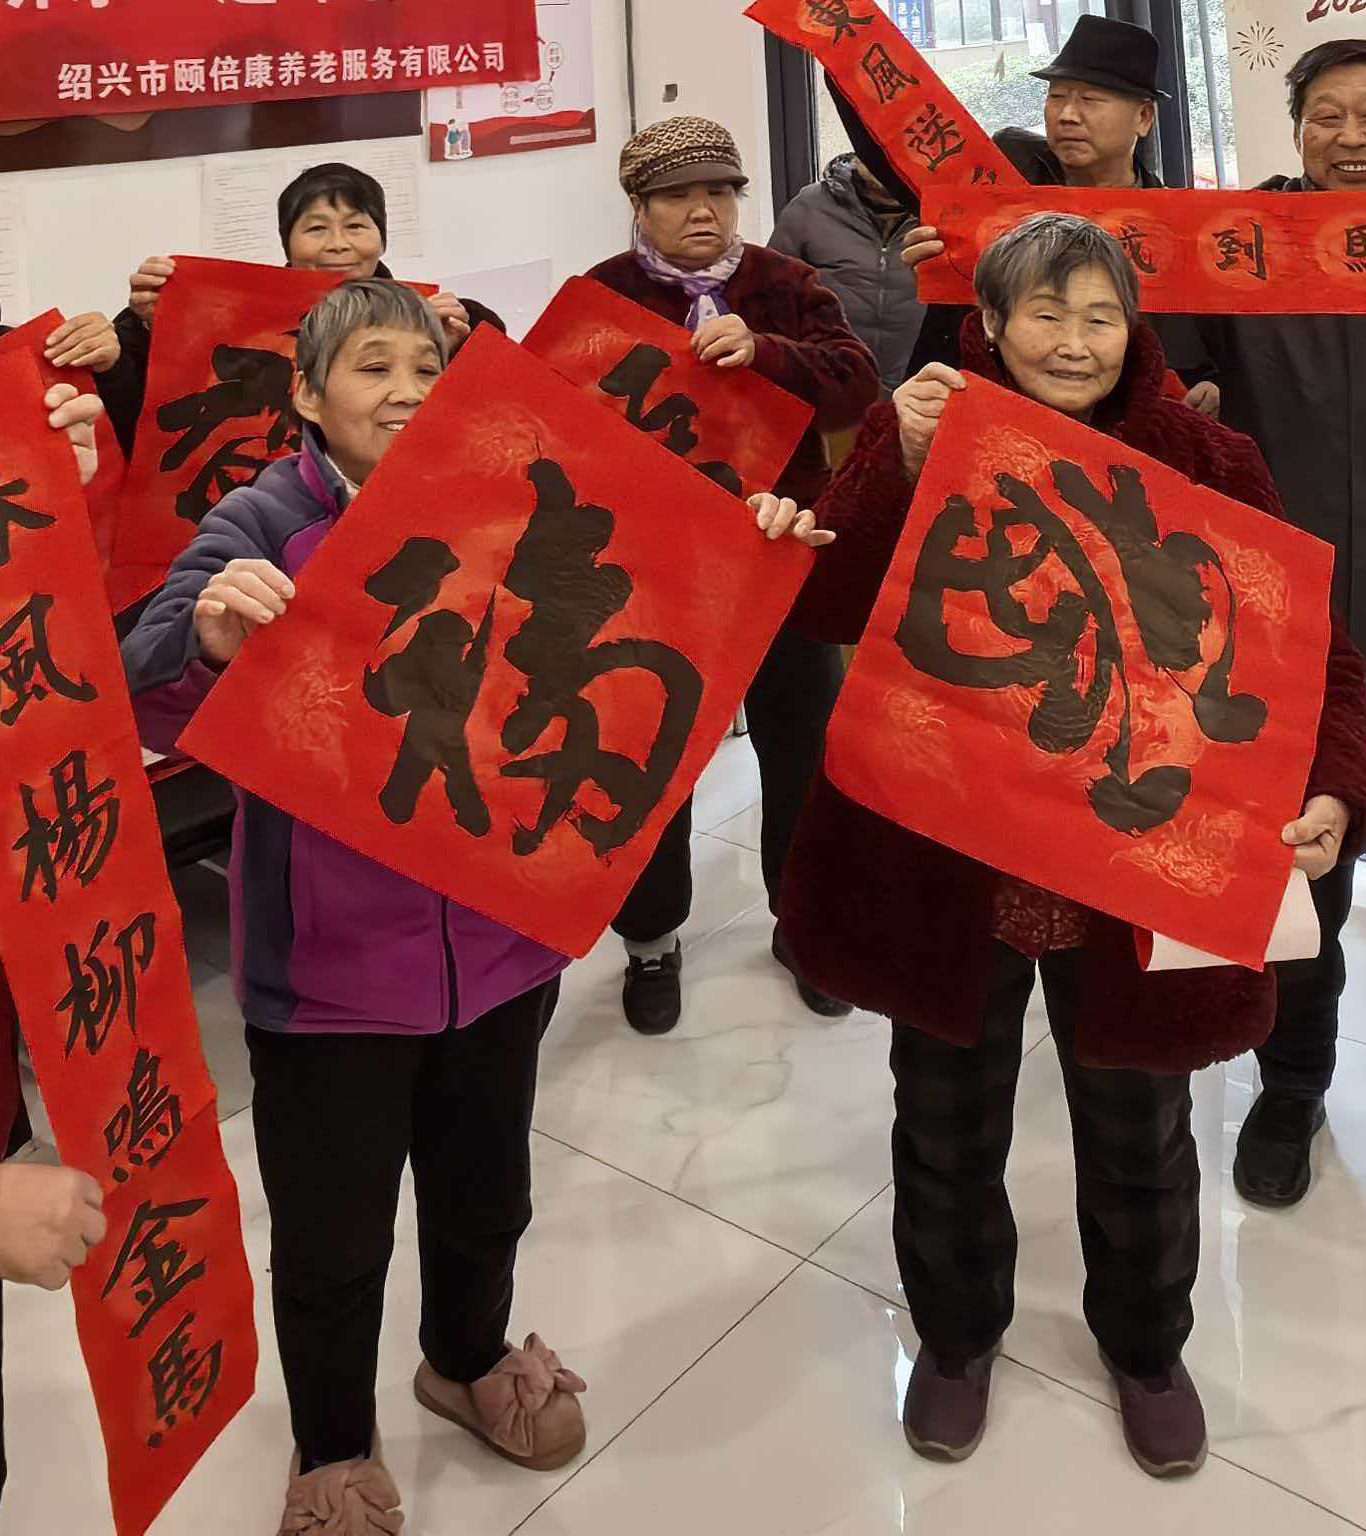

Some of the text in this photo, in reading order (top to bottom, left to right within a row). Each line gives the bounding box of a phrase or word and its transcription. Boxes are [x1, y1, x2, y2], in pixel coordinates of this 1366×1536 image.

[58, 41, 506, 101] 绍兴市颐倍康养老服务有限公司
[362, 448, 705, 866] 福
